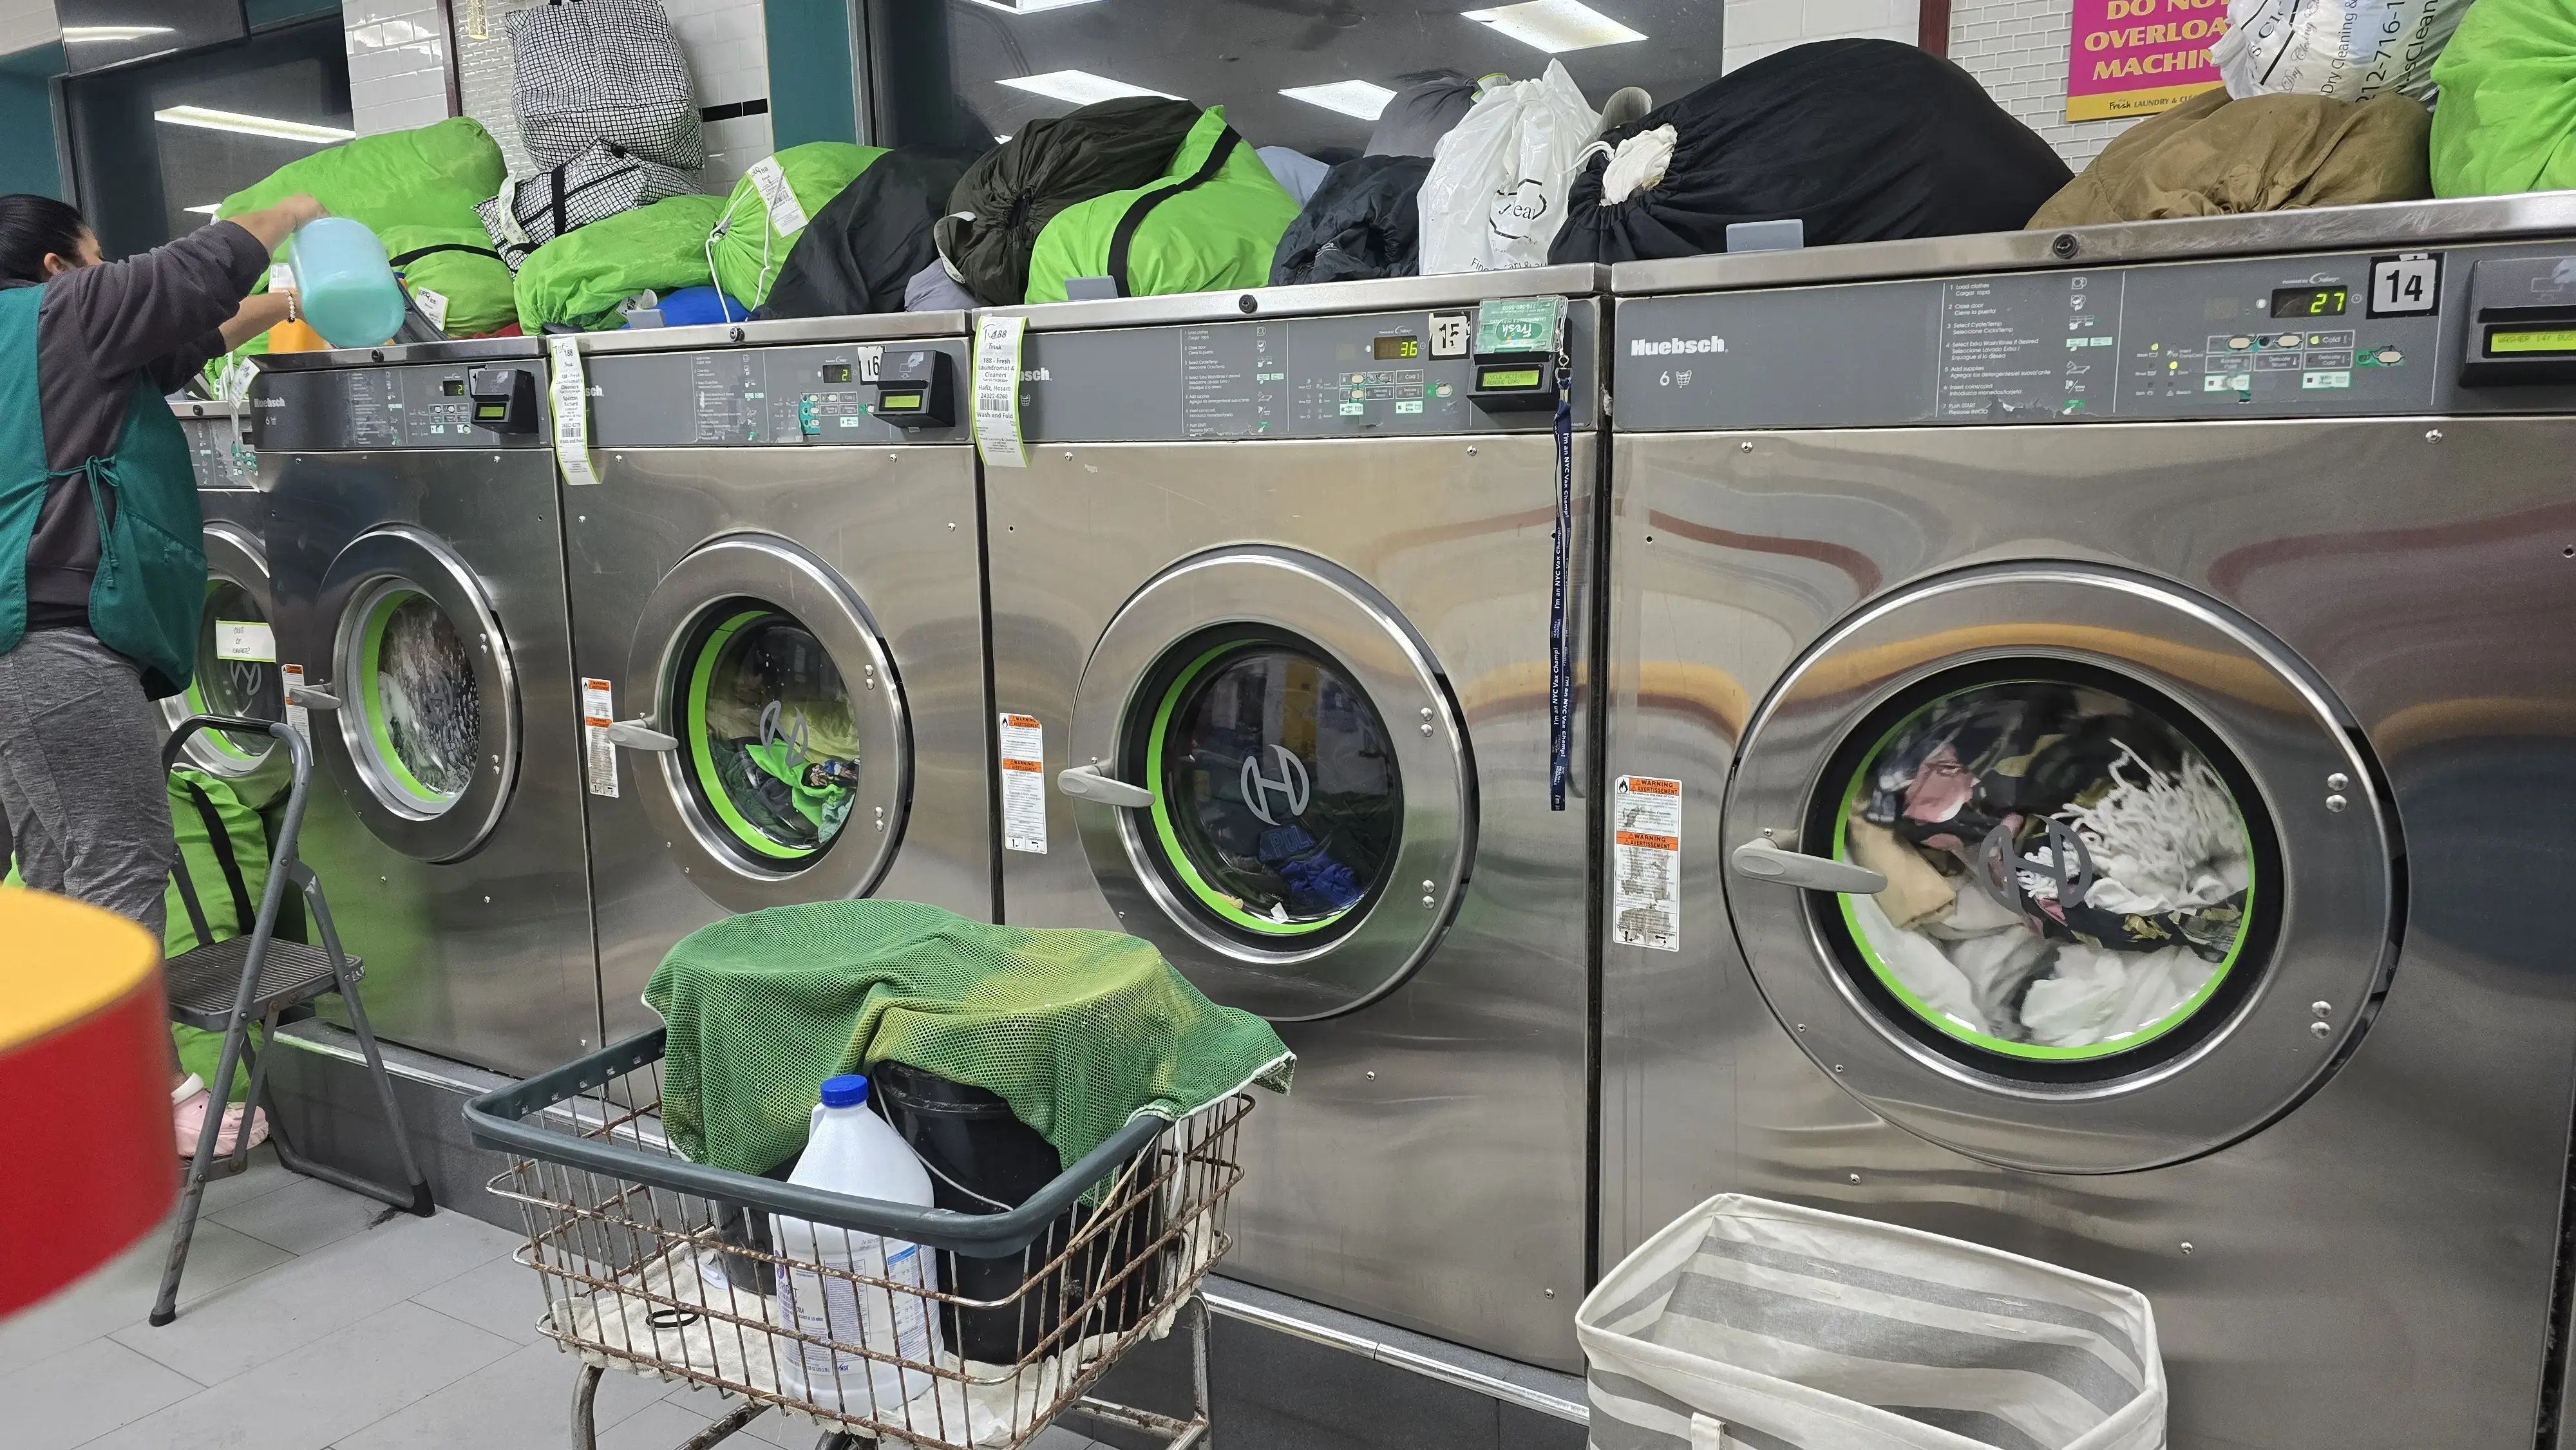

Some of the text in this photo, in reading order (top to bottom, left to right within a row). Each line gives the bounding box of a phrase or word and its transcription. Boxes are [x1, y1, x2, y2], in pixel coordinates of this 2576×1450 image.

[2107, 0, 2155, 20] DO
[2085, 17, 2230, 51] OVERLOA
[2320, 71, 2342, 95] Dry
[2331, 12, 2358, 70] Cleaning
[2093, 49, 2213, 80] MACHIN
[2109, 100, 2130, 110] Fresh
[2134, 98, 2170, 108] LAUNDRY
[2385, 269, 2423, 303] 14
[2309, 292, 2345, 314] 27
[1502, 323, 1532, 338] Fresh
[2557, 333, 2576, 341] BUS
[1400, 341, 1417, 357] 36
[1631, 335, 1725, 356] Huebsch
[867, 355, 879, 376] 16
[842, 369, 848, 381] 2
[1660, 370, 1670, 386] 6
[1564, 446, 1569, 455] an
[1555, 588, 1560, 597] an
[1564, 688, 1569, 697] an
[1553, 705, 1559, 715] an
[1638, 786, 1678, 795] AVERTISSEMENT
[1630, 840, 1671, 849] AVERTISSEMENT
[1634, 833, 1666, 842] WARNING
